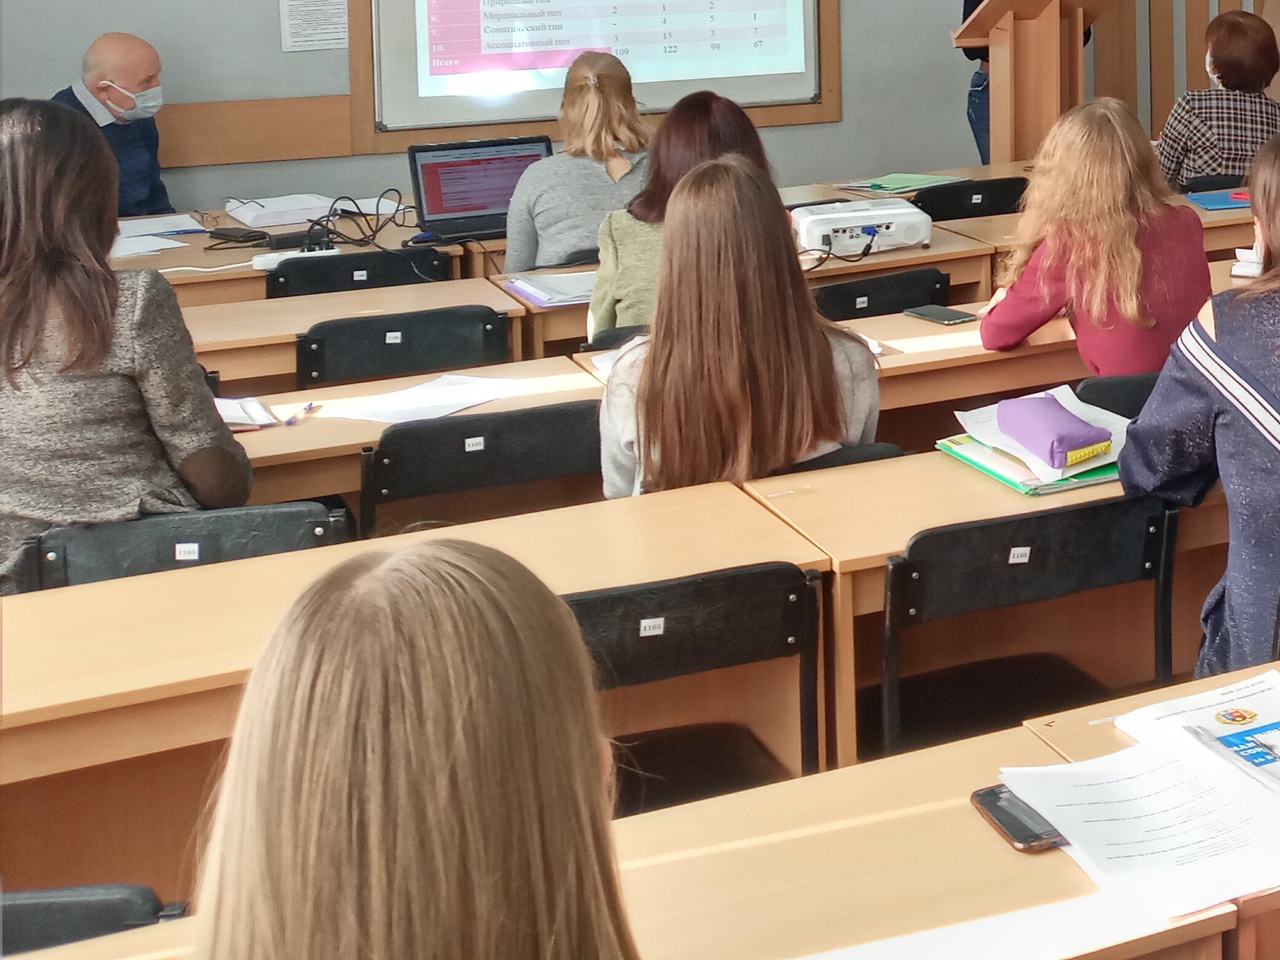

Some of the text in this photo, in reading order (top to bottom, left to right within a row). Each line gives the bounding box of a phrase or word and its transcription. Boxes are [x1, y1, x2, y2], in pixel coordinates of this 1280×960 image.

[484, 24, 546, 34] Соматический
[663, 32, 672, 40] 15
[554, 38, 570, 46] тип
[754, 40, 763, 48] 67
[614, 48, 630, 56] 109
[663, 46, 678, 54] 122
[432, 58, 460, 67] Всего
[642, 623, 662, 632] 1105
